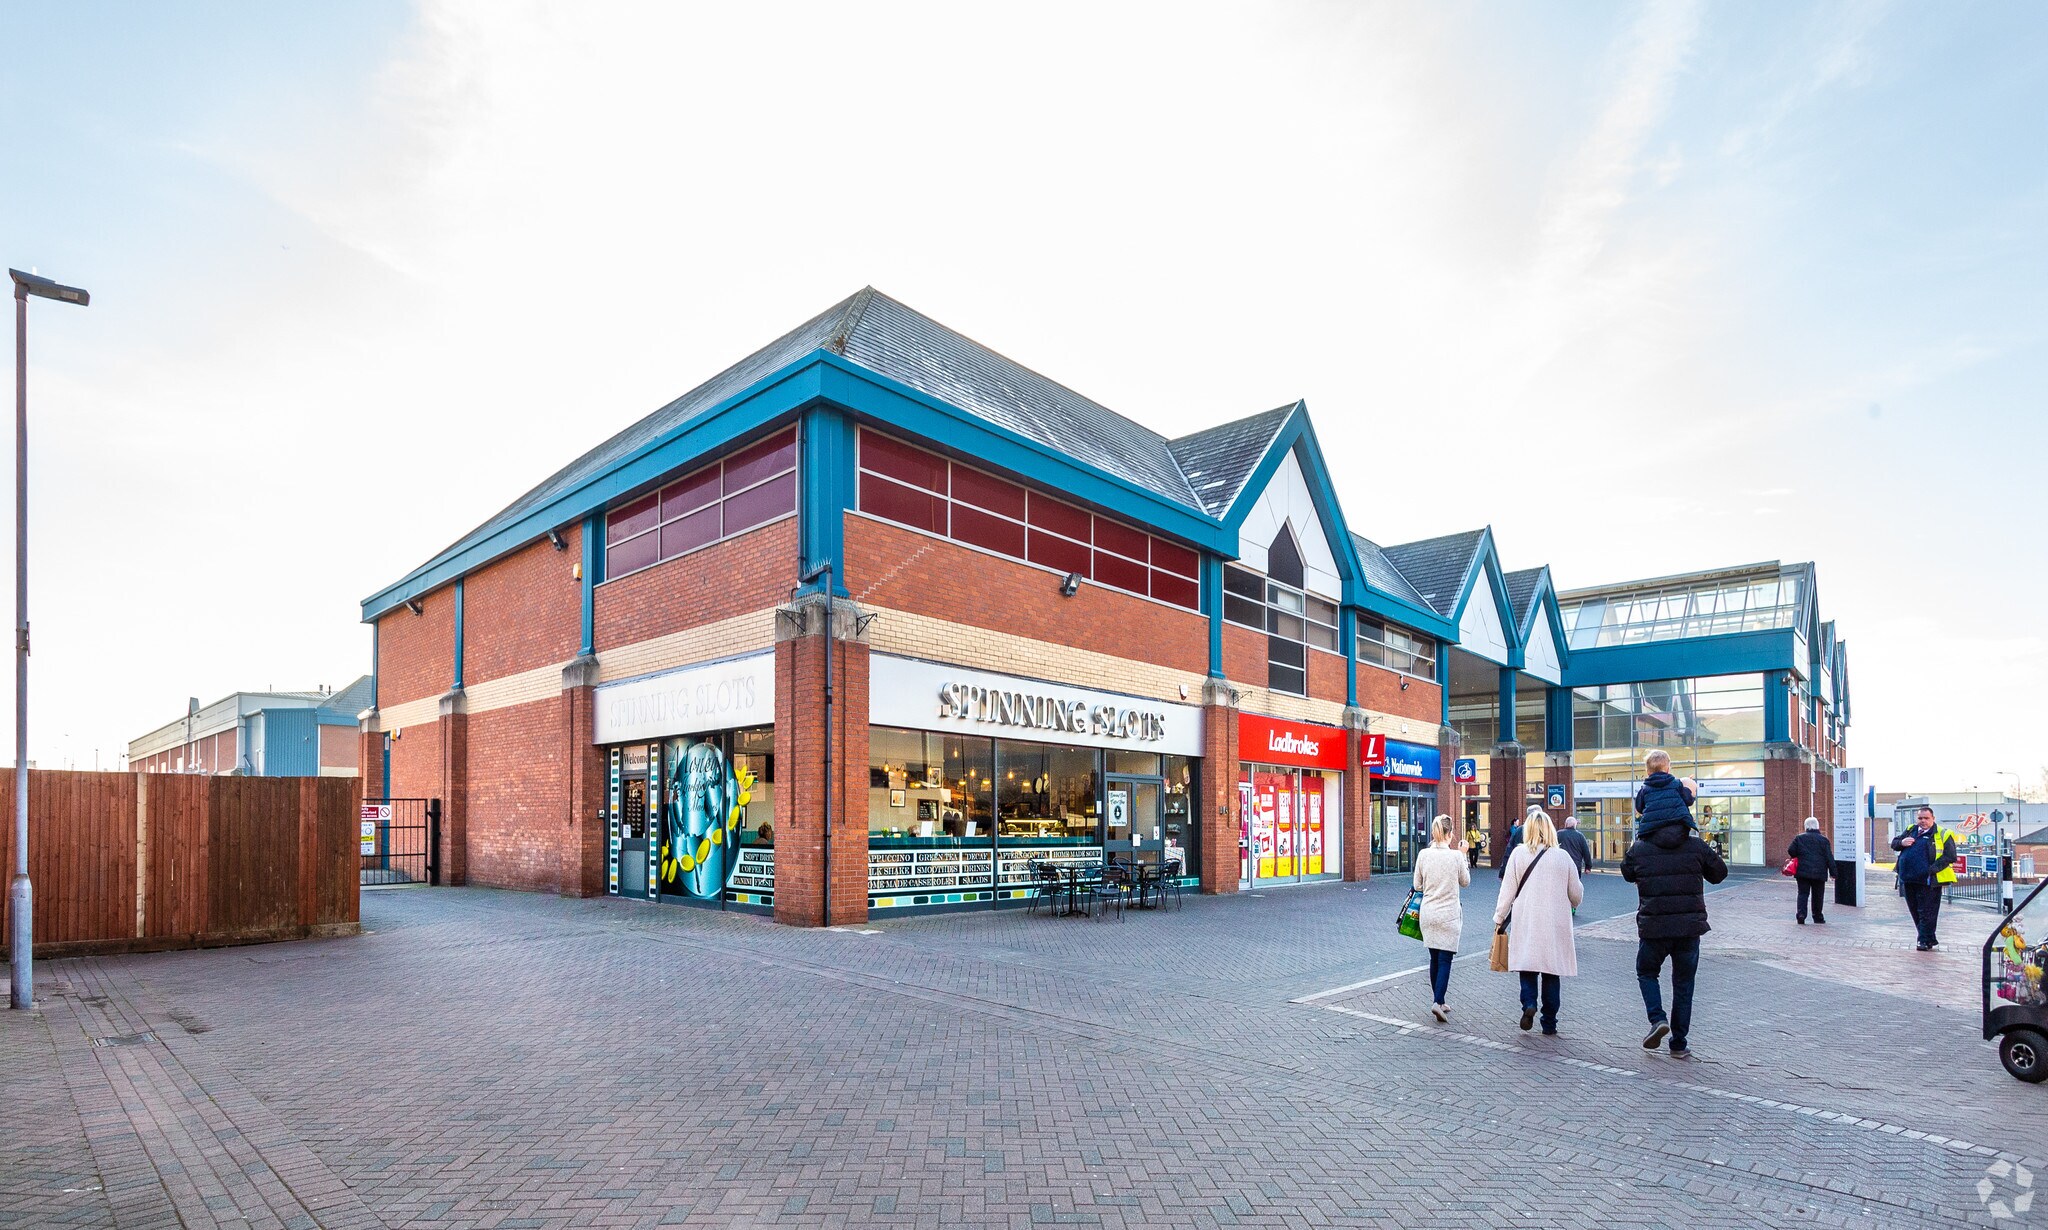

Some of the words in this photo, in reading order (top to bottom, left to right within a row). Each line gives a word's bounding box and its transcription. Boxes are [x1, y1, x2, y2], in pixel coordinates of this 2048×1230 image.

[610, 688, 689, 728] SPINNING
[696, 675, 755, 716] SLOTS
[940, 682, 1087, 734] SPINNING
[1091, 703, 1167, 742] SLOTS
[1268, 729, 1319, 757] Ladbrokes
[623, 753, 648, 765] Welcome
[1391, 757, 1423, 777] Nationwide
[745, 852, 759, 861] SOFT
[760, 853, 775, 862] DRIN
[867, 853, 911, 863] APPUCCINO
[918, 852, 943, 862] GREEN
[944, 852, 958, 861] TEA
[966, 851, 988, 861] DECAF
[1037, 851, 1048, 859] TEA
[1053, 850, 1070, 858] HOME
[1070, 850, 1085, 858] MADE
[1086, 849, 1100, 857] SOUP
[741, 865, 763, 874] COFFEE
[767, 866, 775, 874] ES
[868, 867, 883, 876] ILK
[884, 866, 910, 875] SHAKE
[916, 865, 958, 874] SMOOTHIES
[963, 863, 990, 873] DRINKS
[1004, 863, 1029, 872] CROISS
[734, 876, 752, 885] PANINI
[867, 879, 885, 889] OME
[886, 878, 908, 888] MADE
[908, 876, 954, 888] CASSEROLES
[962, 875, 989, 885] SALADS
